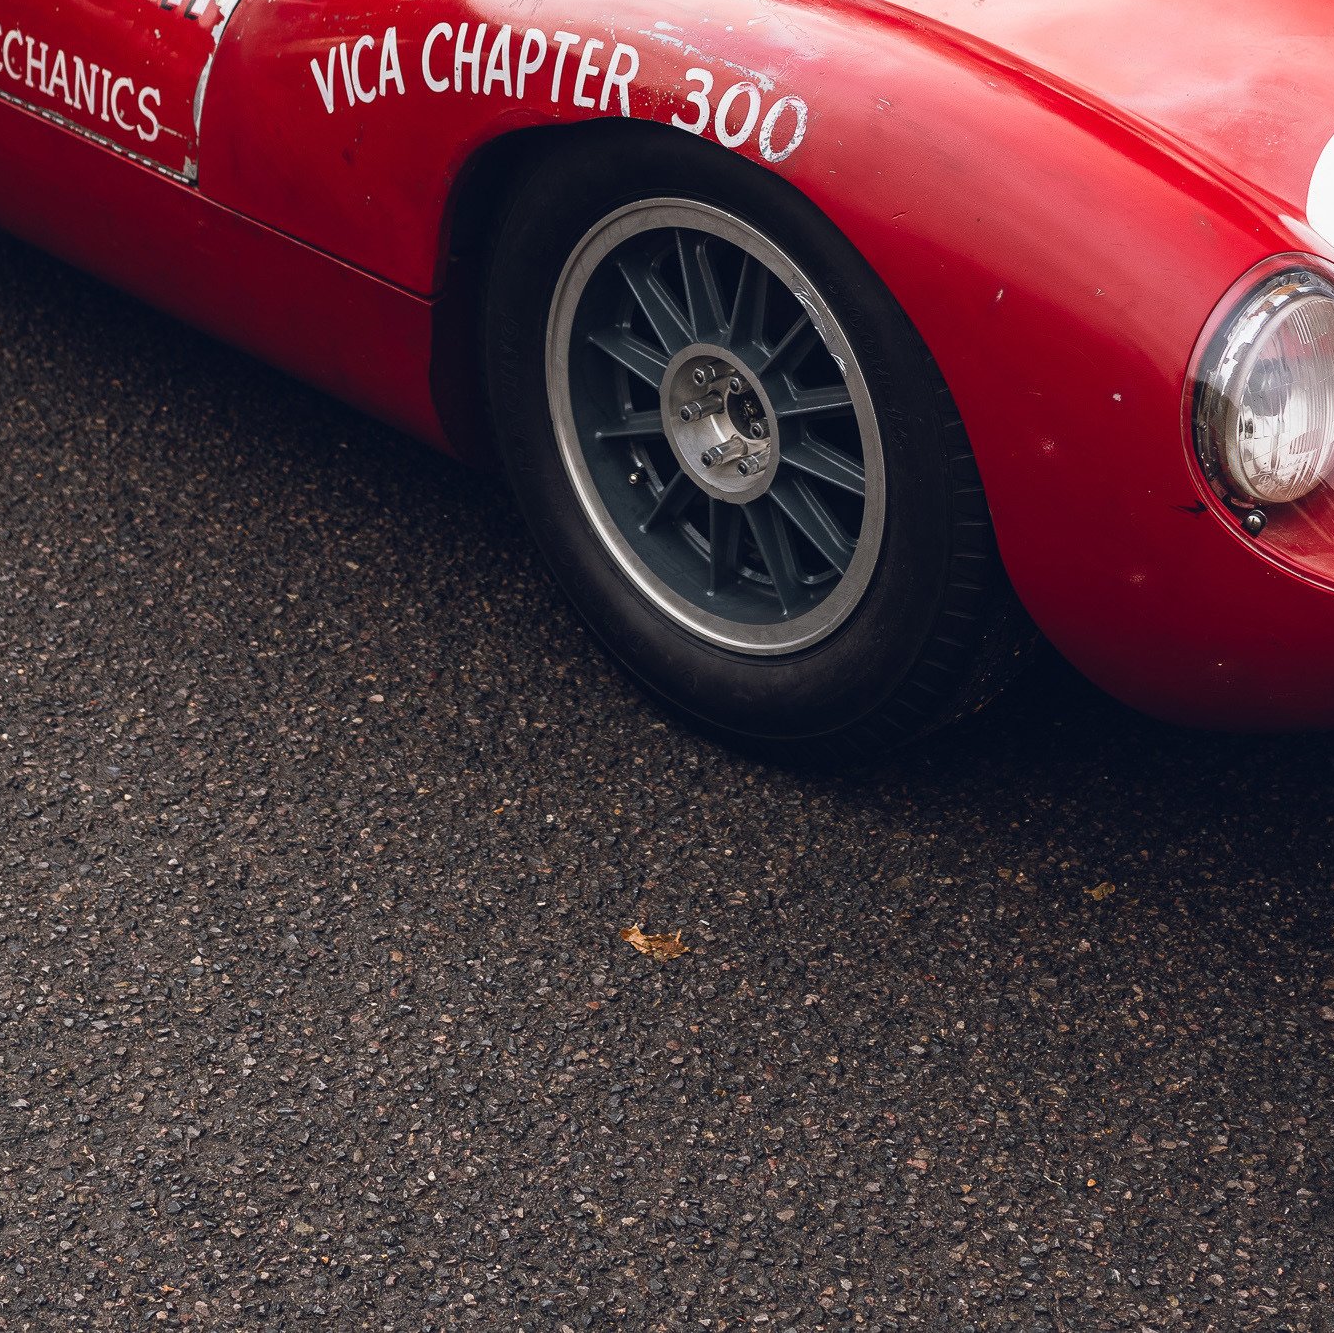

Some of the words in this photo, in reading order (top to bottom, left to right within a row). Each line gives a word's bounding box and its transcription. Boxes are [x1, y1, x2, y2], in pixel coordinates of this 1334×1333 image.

[310, 26, 405, 114] VICA
[421, 22, 640, 118] CHAPTER
[671, 67, 809, 164] 300
